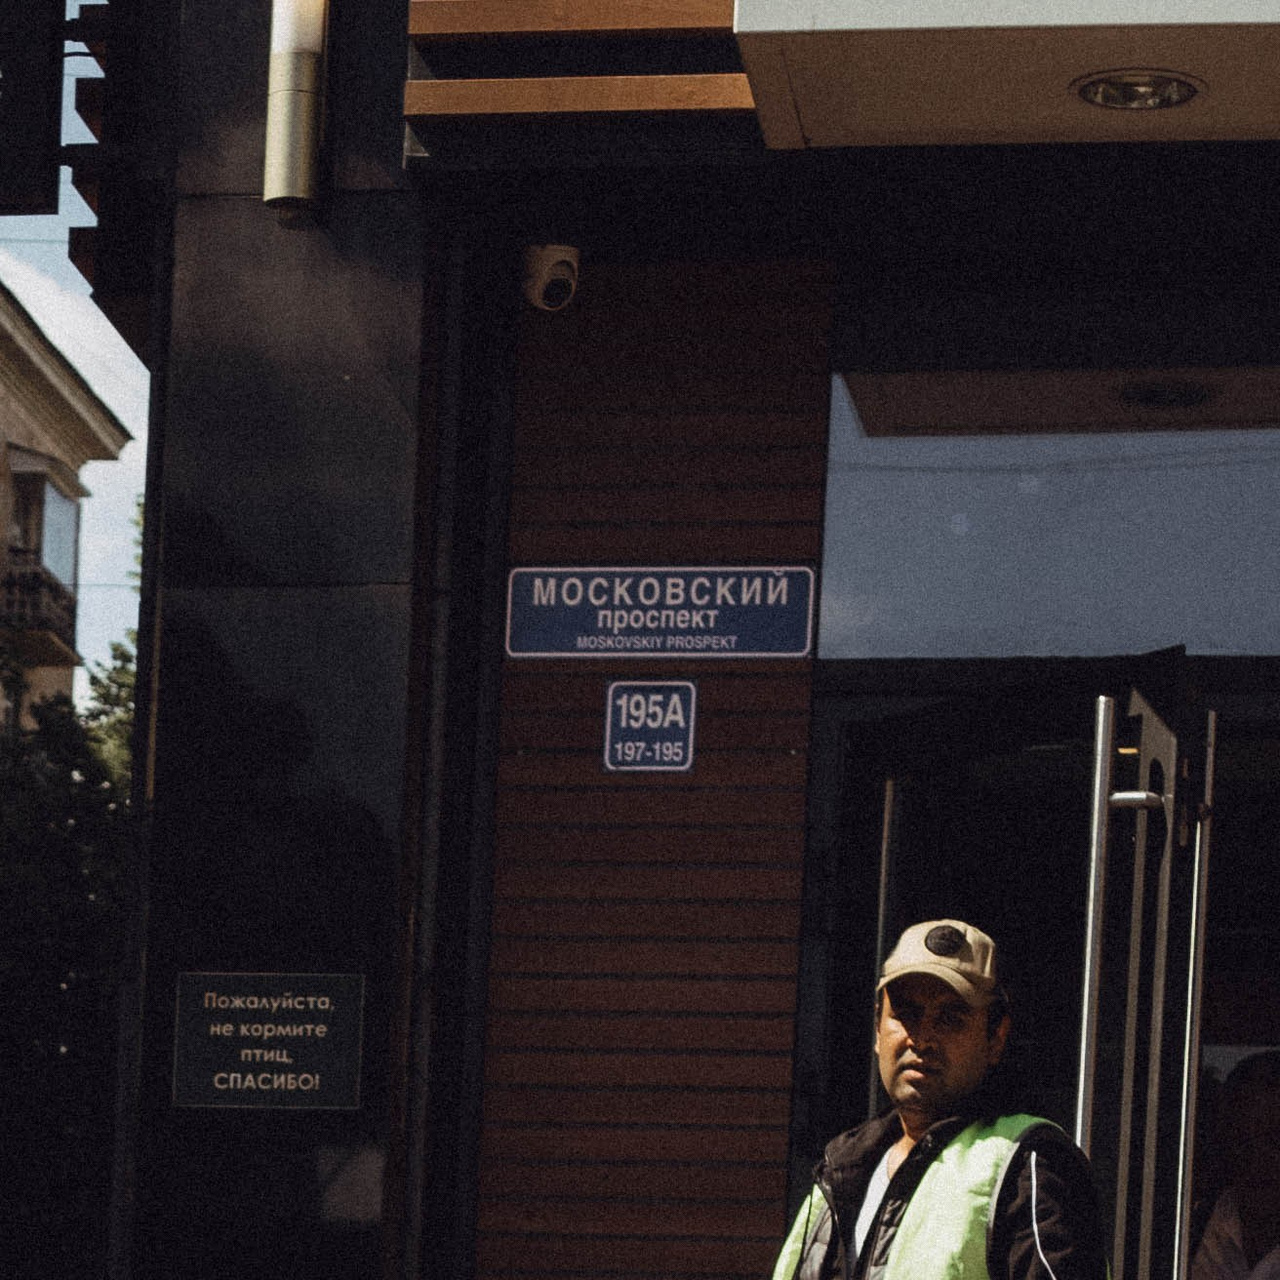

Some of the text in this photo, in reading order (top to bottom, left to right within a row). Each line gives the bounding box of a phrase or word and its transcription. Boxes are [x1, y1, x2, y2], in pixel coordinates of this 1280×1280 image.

[533, 569, 789, 605] МОСКОВСКИЙ
[597, 609, 719, 633] проспект
[576, 635, 738, 649] MOSKOVSKIY PROSPEKT
[616, 694, 685, 729] 195А
[614, 742, 683, 762] 197-195
[203, 991, 335, 1013] Пожалуйста,
[209, 1022, 329, 1040] не кормите
[213, 1072, 321, 1090] СПАСИБО!
